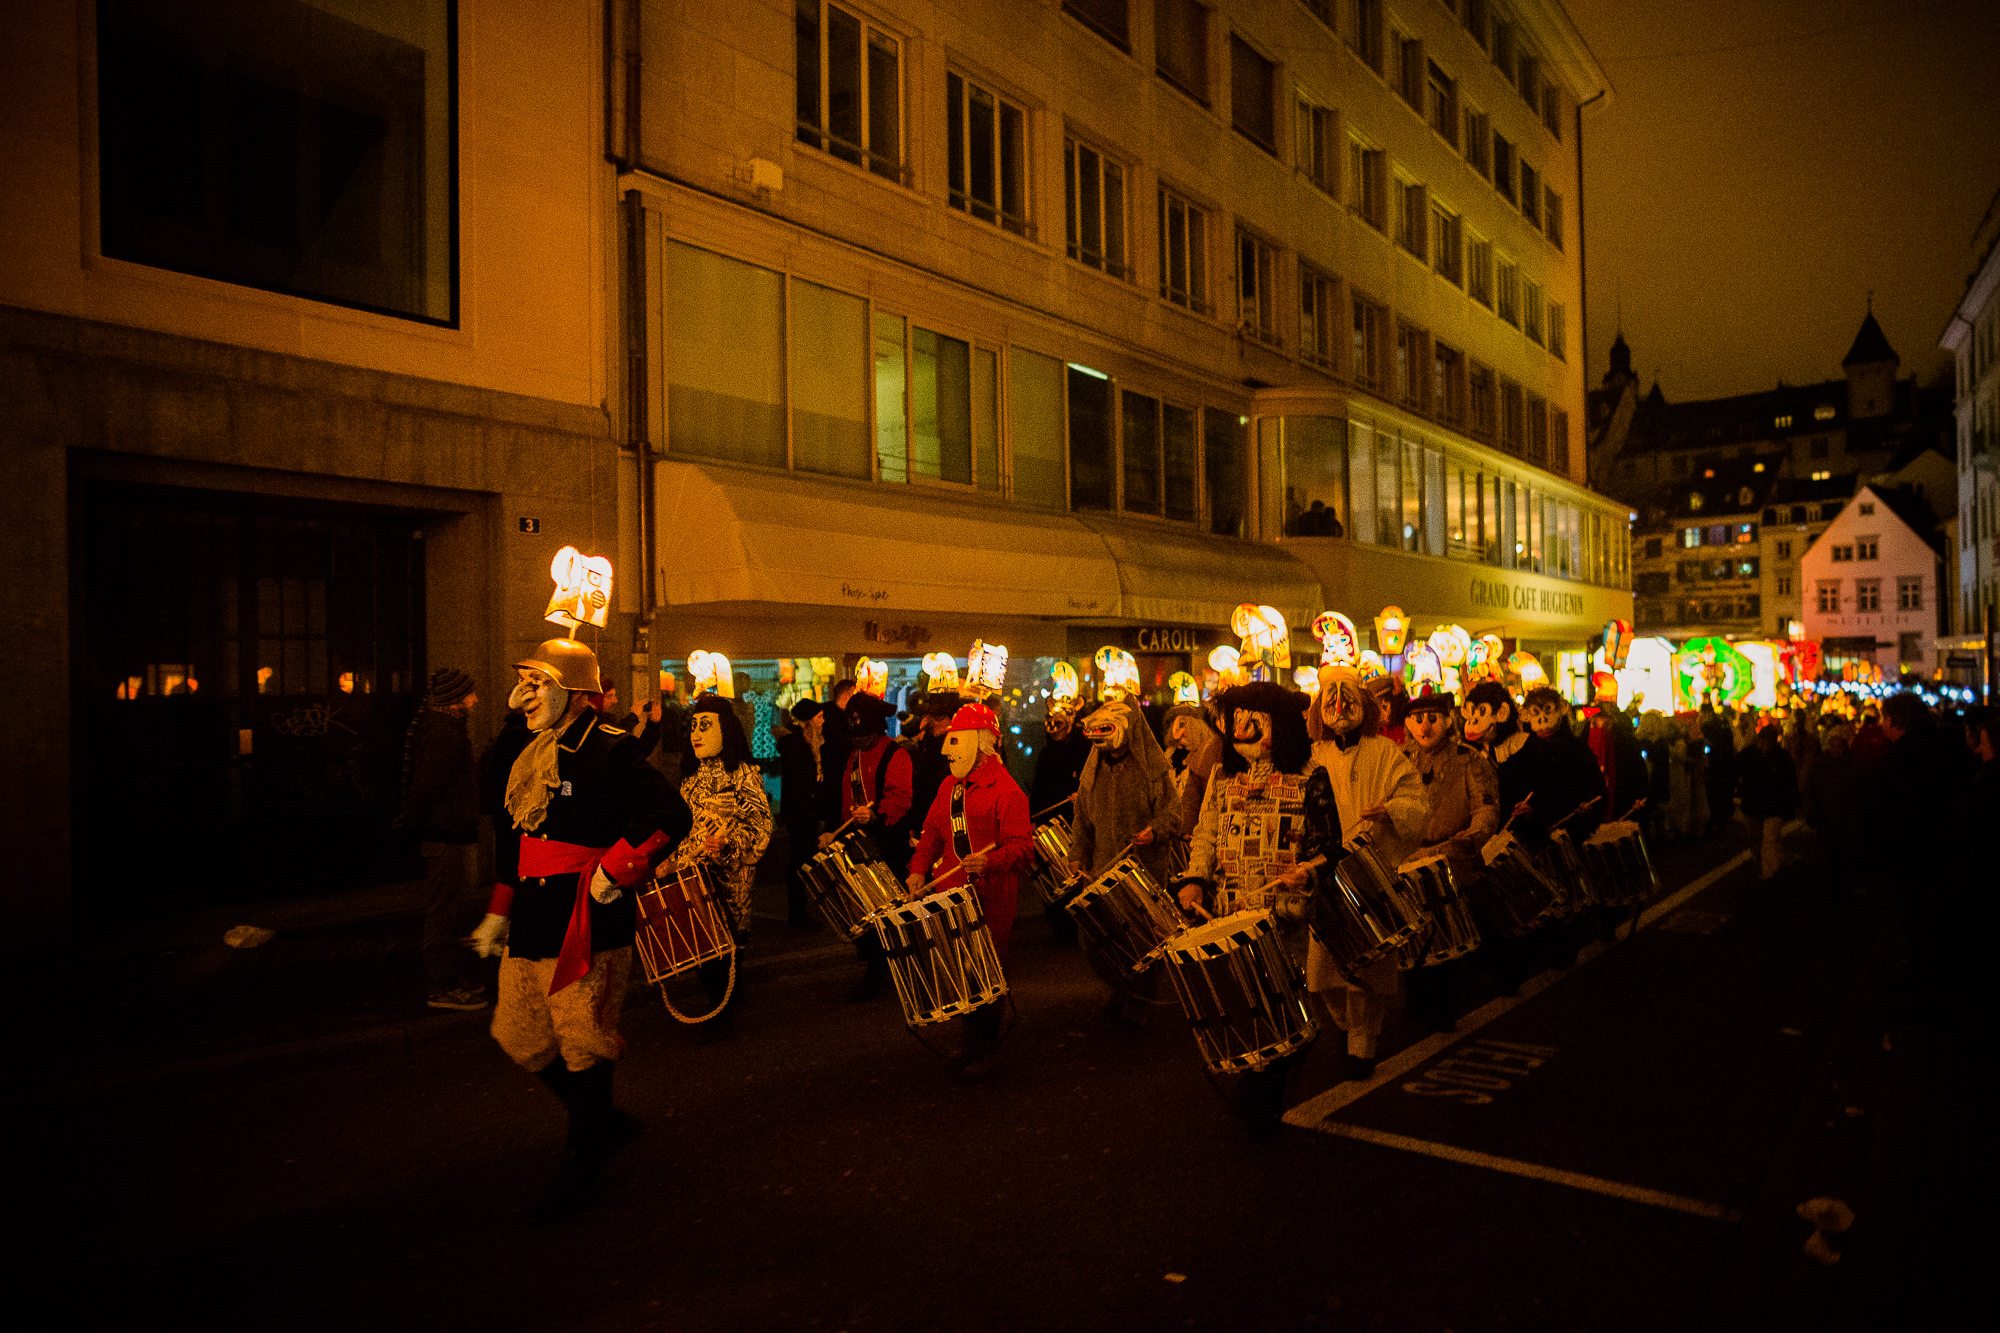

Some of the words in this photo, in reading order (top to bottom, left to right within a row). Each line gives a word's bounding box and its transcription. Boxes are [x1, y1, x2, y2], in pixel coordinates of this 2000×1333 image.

[525, 518, 534, 532] 3
[1470, 578, 1510, 609] GRAND
[1540, 589, 1584, 616] HUGUENIN
[1137, 627, 1200, 652] CAROLL
